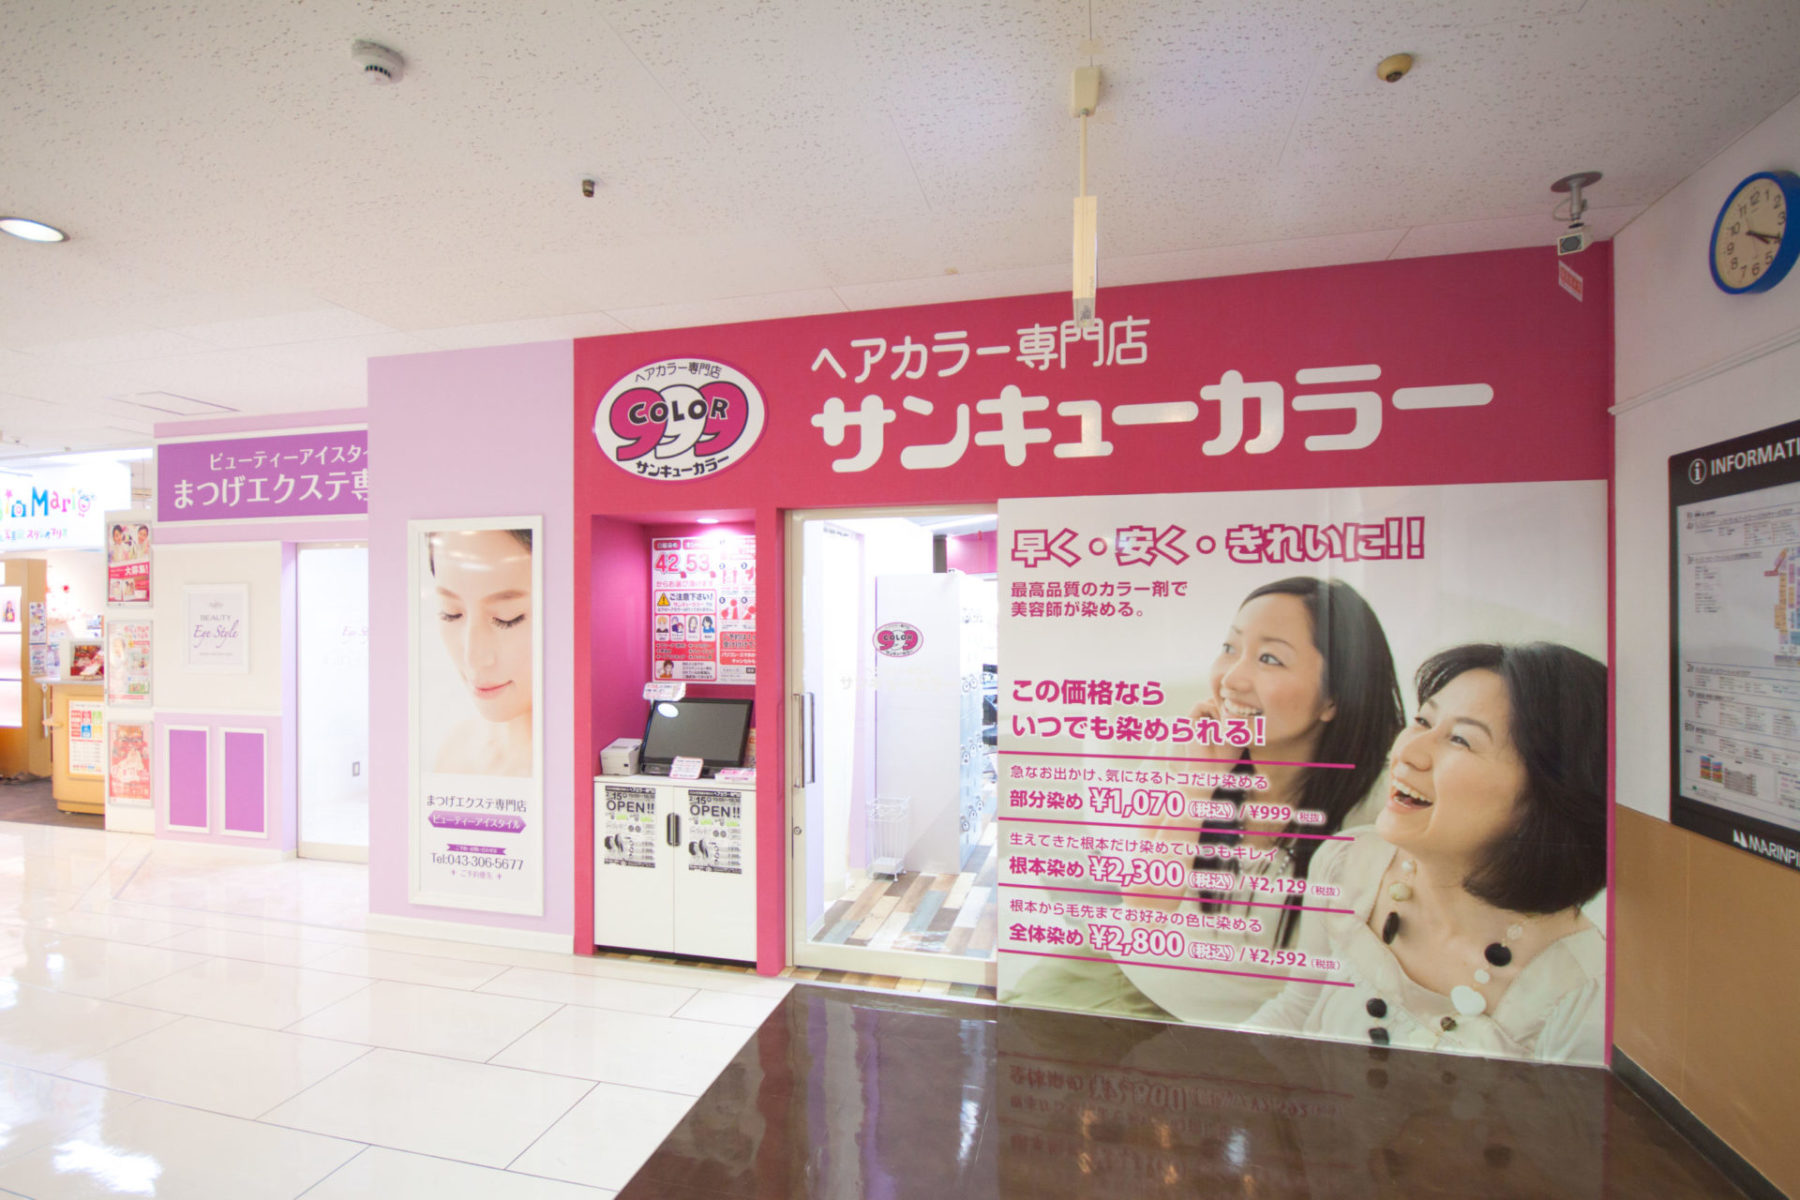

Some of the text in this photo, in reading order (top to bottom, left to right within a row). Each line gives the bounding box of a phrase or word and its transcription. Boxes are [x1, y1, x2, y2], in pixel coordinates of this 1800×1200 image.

[811, 315, 1150, 383] ヘアカラー専門店
[635, 362, 722, 383] ヘアカラー専門店
[609, 380, 750, 462] 999
[629, 397, 730, 425] COLOR
[811, 363, 1494, 473] サンキューカラー
[636, 456, 730, 478] サンキューカラー
[1011, 516, 1426, 568] 早く・安く・きれいに!!
[1011, 580, 1188, 598] 最高品質のカラー剤で
[1011, 600, 1144, 618] 美容師が染める。
[1012, 679, 1165, 706] この価格なら
[1012, 714, 1266, 746] いつでも染められる!
[1010, 765, 1269, 789] 急なお出かけ、気になるトコだけ染める
[427, 795, 527, 813] まつげエクステ専門店
[1010, 790, 1084, 809] 部分染め
[1088, 787, 1185, 818] ¥1,070
[433, 814, 521, 830] ビューティーアイスタイル
[1010, 832, 1279, 862] 生えてきた根本だけ染めていつもキレイ
[1009, 856, 1084, 878] 根本染め
[1088, 855, 1185, 887] ¥2,300
[1010, 898, 1263, 932] 根本から毛先までお好みの色に染める
[1009, 923, 1084, 946] 全体染め
[1088, 923, 1185, 957] ¥2,800
